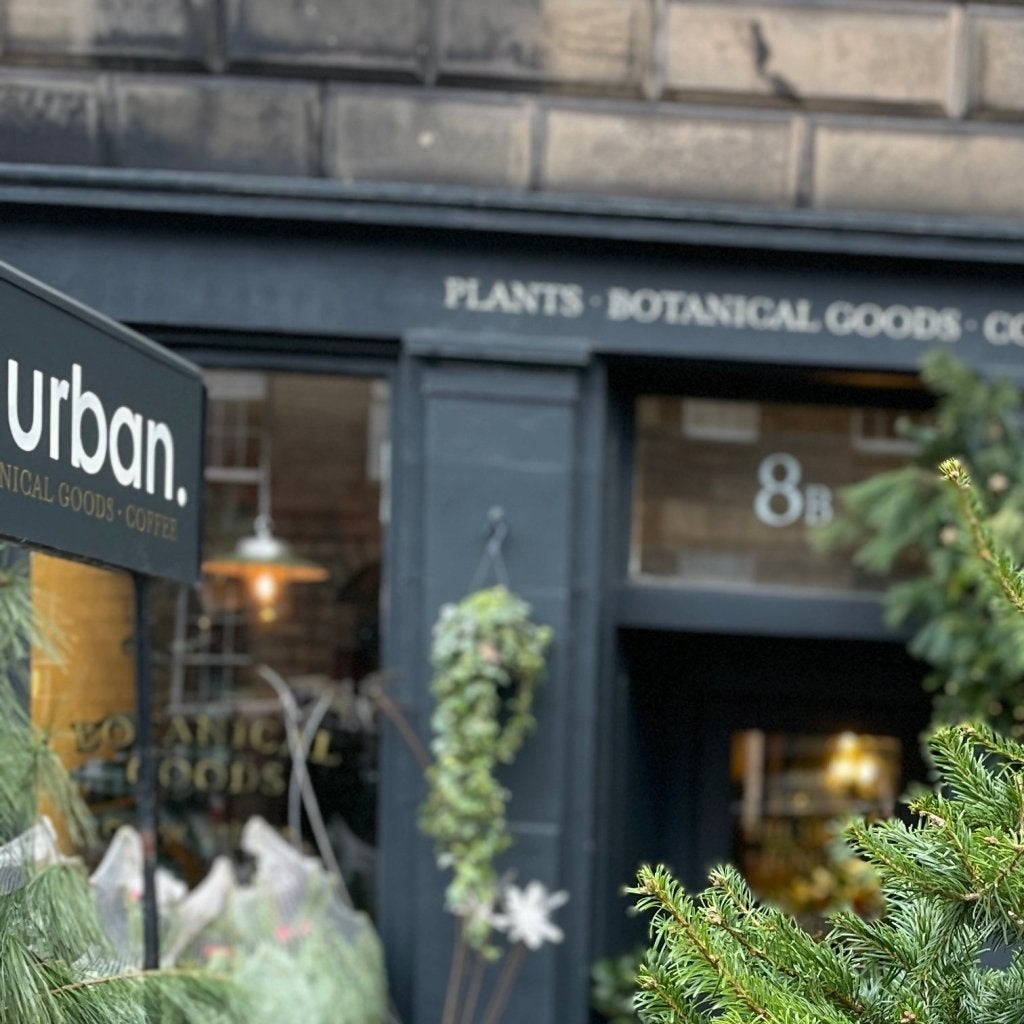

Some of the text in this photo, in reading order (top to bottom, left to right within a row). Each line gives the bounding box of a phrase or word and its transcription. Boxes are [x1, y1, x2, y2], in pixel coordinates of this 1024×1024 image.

[444, 276, 585, 319] PLANTS
[607, 286, 822, 333] BOTANICAL
[825, 300, 962, 343] GOODS
[7, 358, 188, 508] urban.
[58, 481, 115, 522] GOODS
[125, 503, 178, 541] COFFEE
[70, 713, 343, 769] BOANICL
